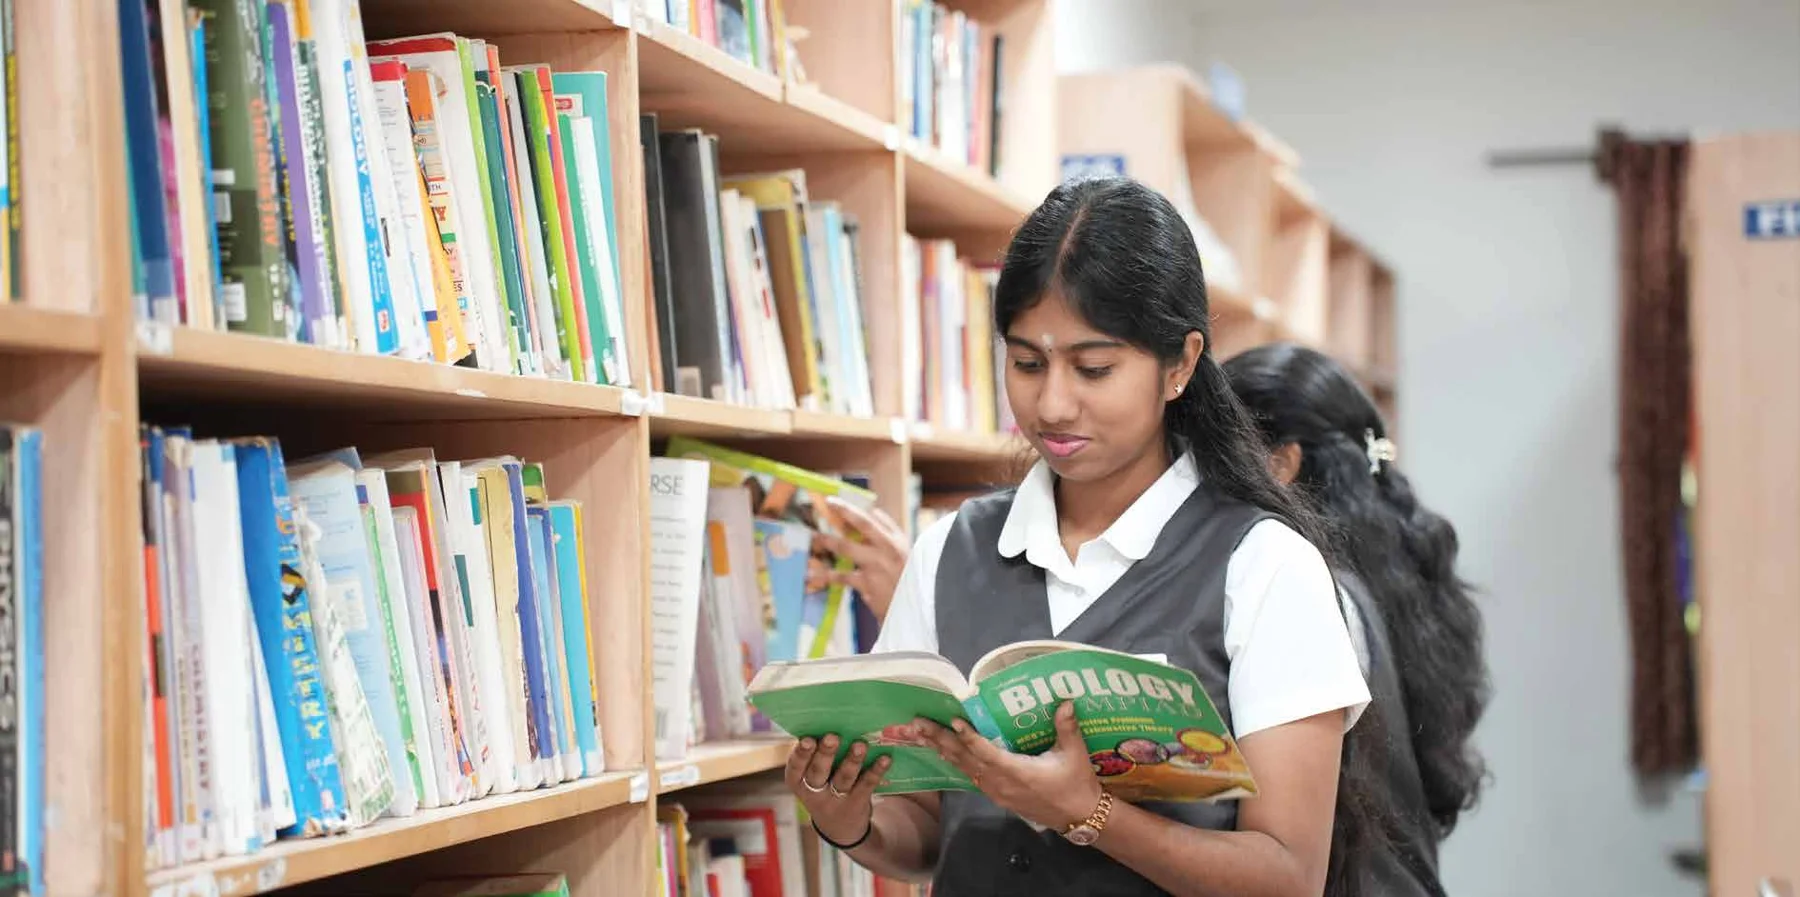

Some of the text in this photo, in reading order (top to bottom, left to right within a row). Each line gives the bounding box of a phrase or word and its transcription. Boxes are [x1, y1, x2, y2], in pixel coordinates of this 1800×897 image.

[346, 70, 369, 175] BIOLOGY
[1000, 668, 1198, 716] BIOLOGY
[1013, 697, 1204, 729] OLMPIAD
